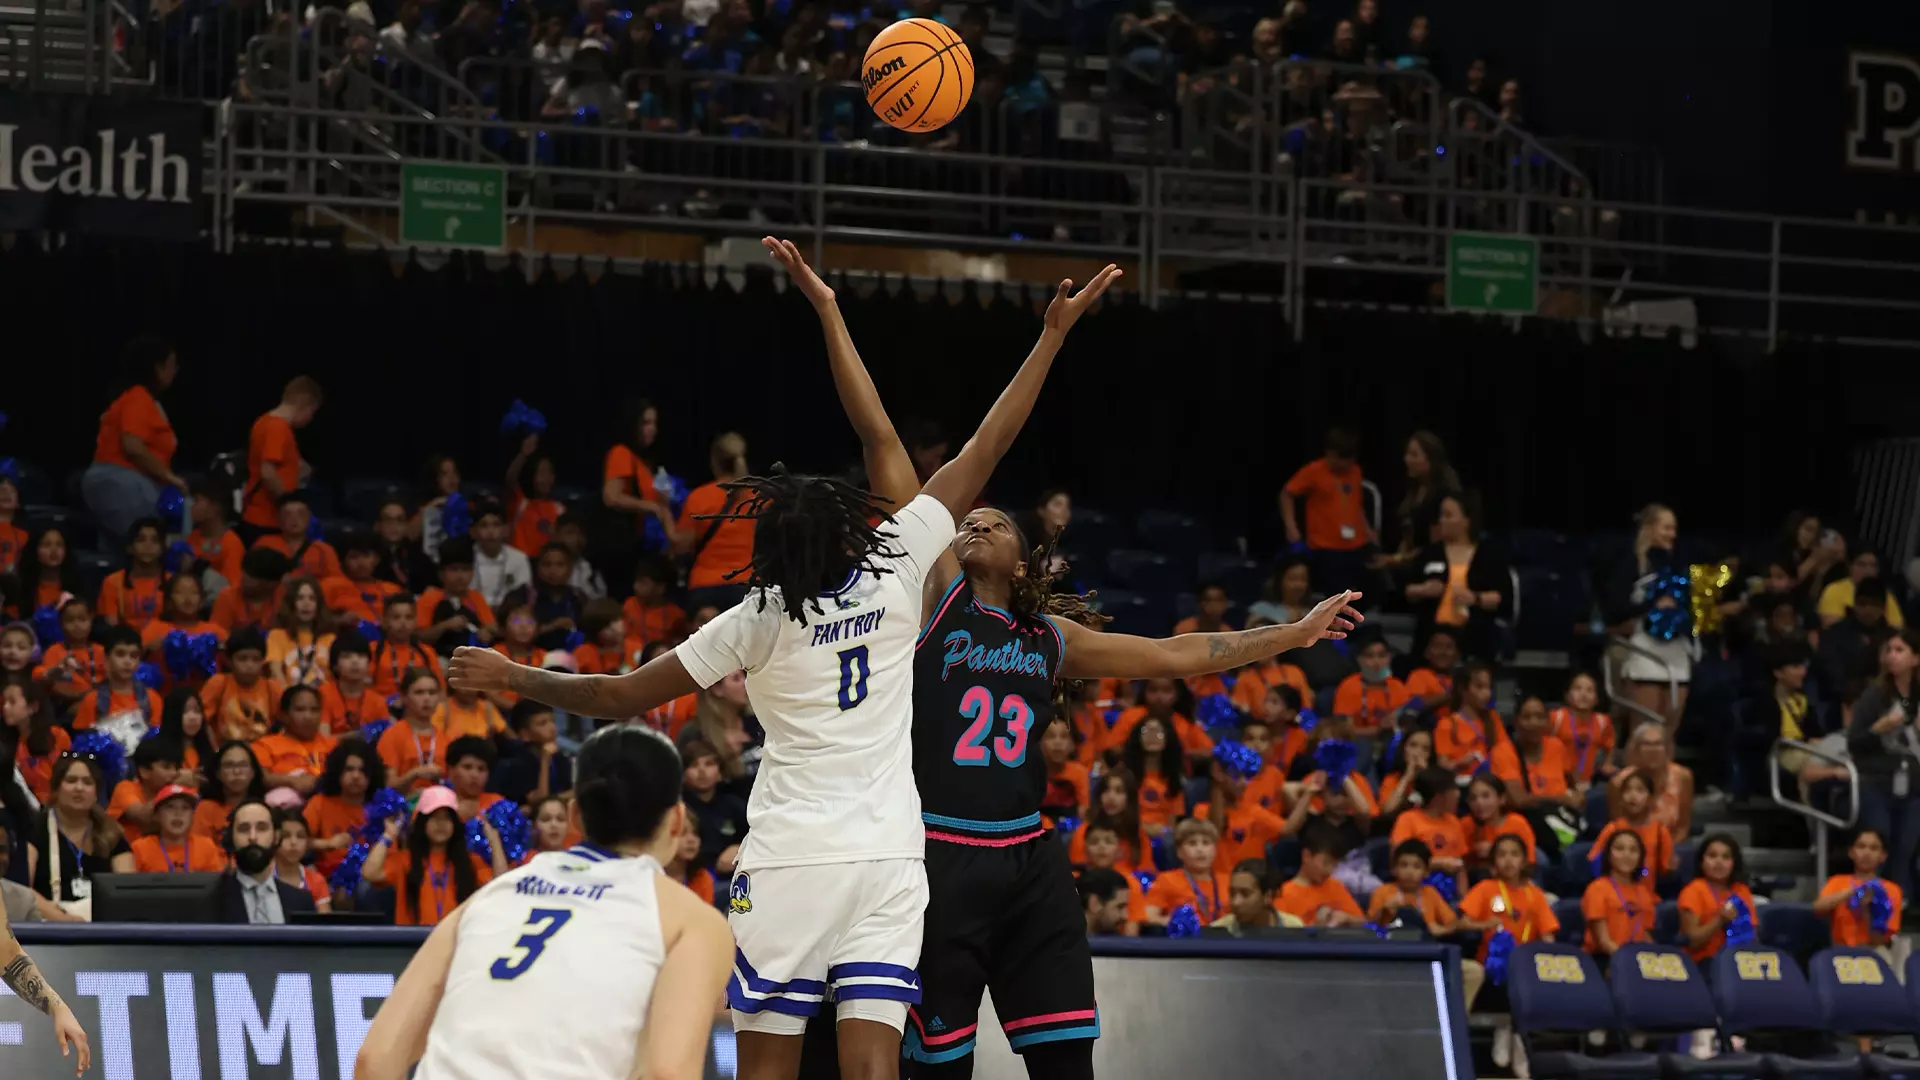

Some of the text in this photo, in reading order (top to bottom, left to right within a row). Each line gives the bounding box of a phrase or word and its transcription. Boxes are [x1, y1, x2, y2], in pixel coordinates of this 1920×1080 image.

[810, 606, 886, 648] FANTROY
[836, 643, 872, 713] 0
[952, 685, 1036, 769] 23
[489, 907, 573, 982] 3
